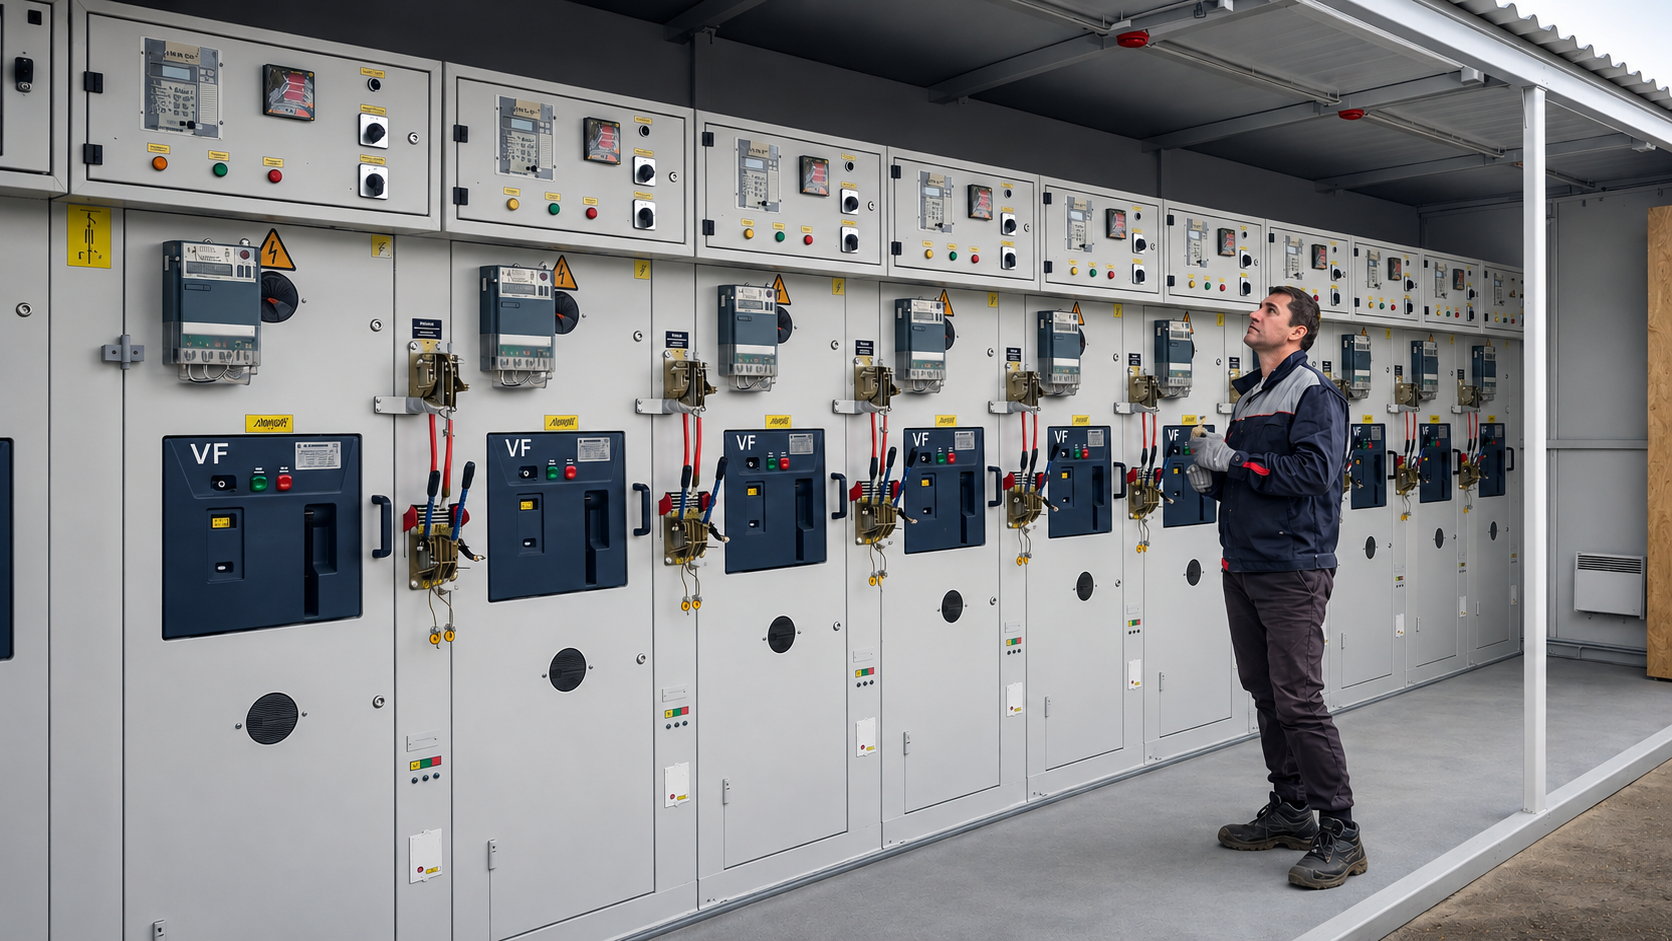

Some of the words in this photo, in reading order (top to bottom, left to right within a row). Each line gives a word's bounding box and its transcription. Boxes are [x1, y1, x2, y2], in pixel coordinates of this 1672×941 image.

[1054, 430, 1069, 444] VF
[1167, 429, 1180, 442] VF
[1352, 426, 1362, 437] VF
[736, 434, 756, 451] VF
[912, 432, 930, 447] VF
[190, 442, 229, 465] VF
[504, 438, 532, 457] VF
